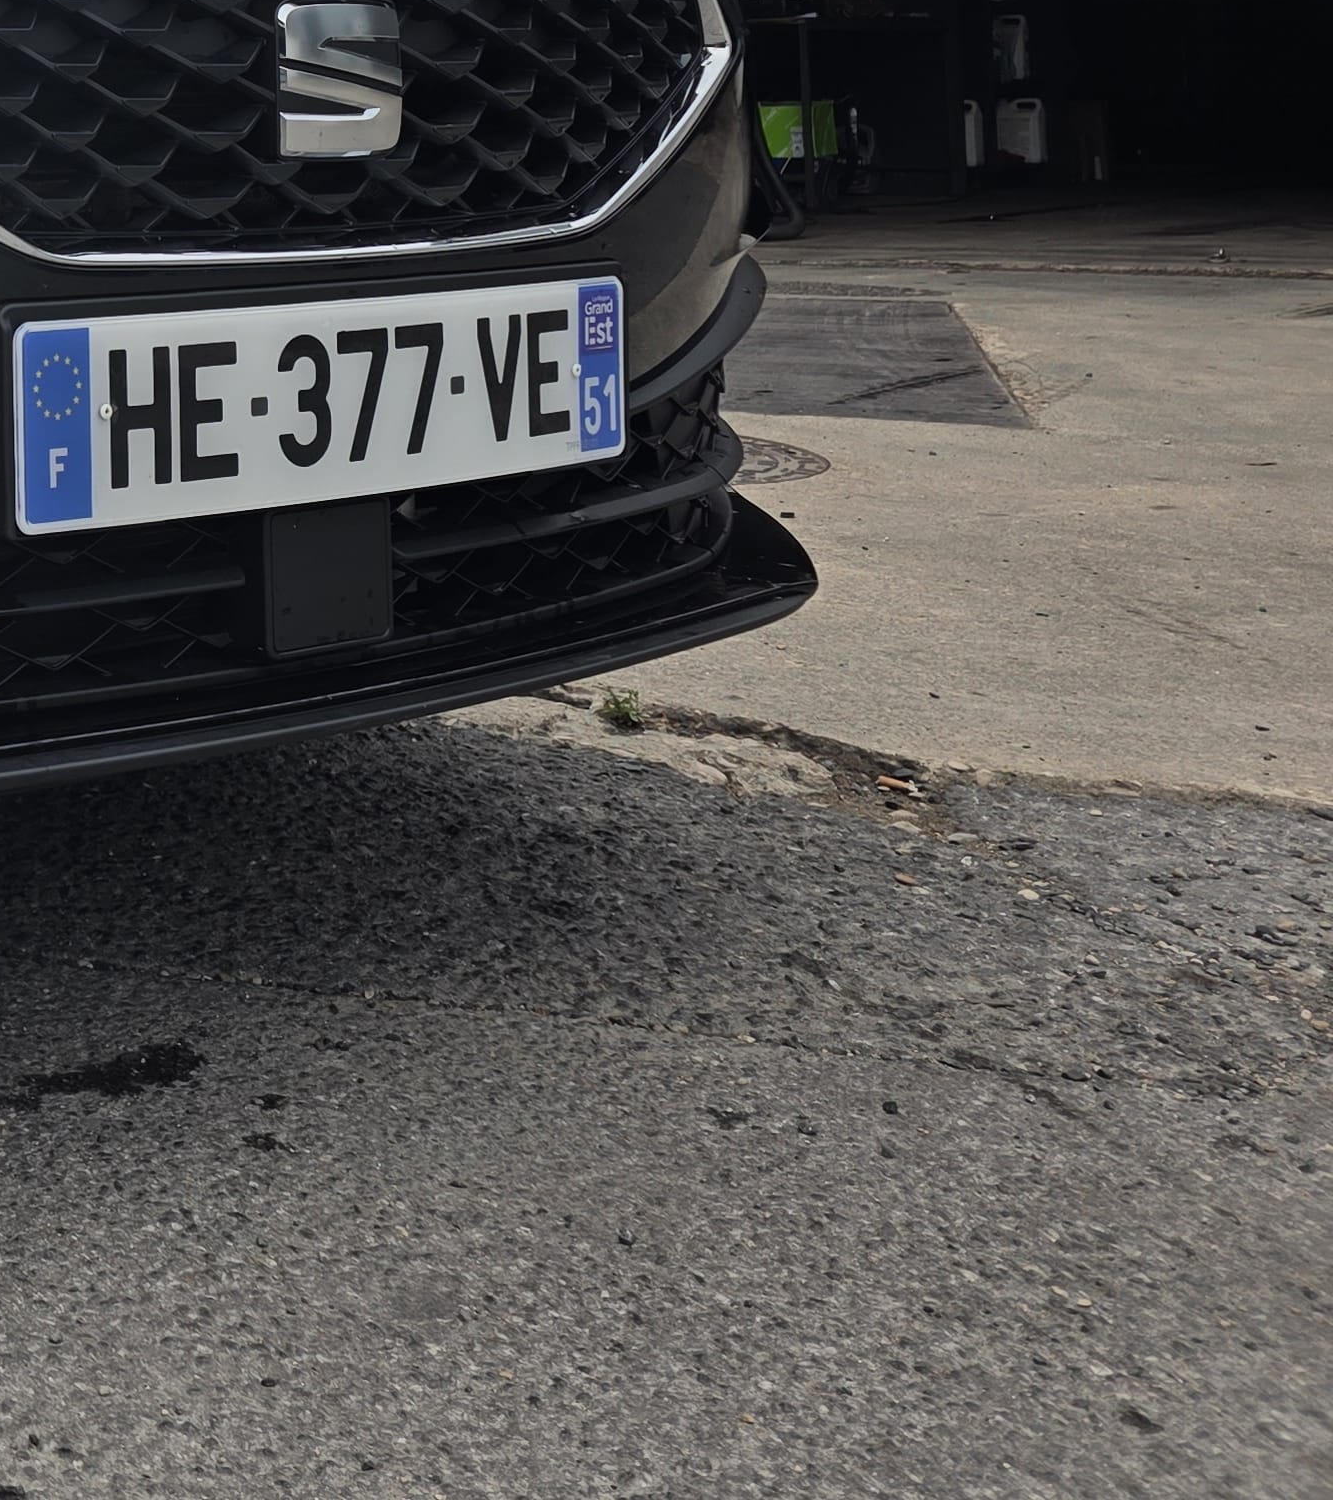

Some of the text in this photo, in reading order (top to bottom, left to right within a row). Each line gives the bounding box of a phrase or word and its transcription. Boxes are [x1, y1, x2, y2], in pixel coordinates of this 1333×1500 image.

[584, 299, 614, 316] Grand
[108, 309, 572, 491] HE-377-VE
[584, 373, 617, 436] 51
[48, 447, 69, 490] F
